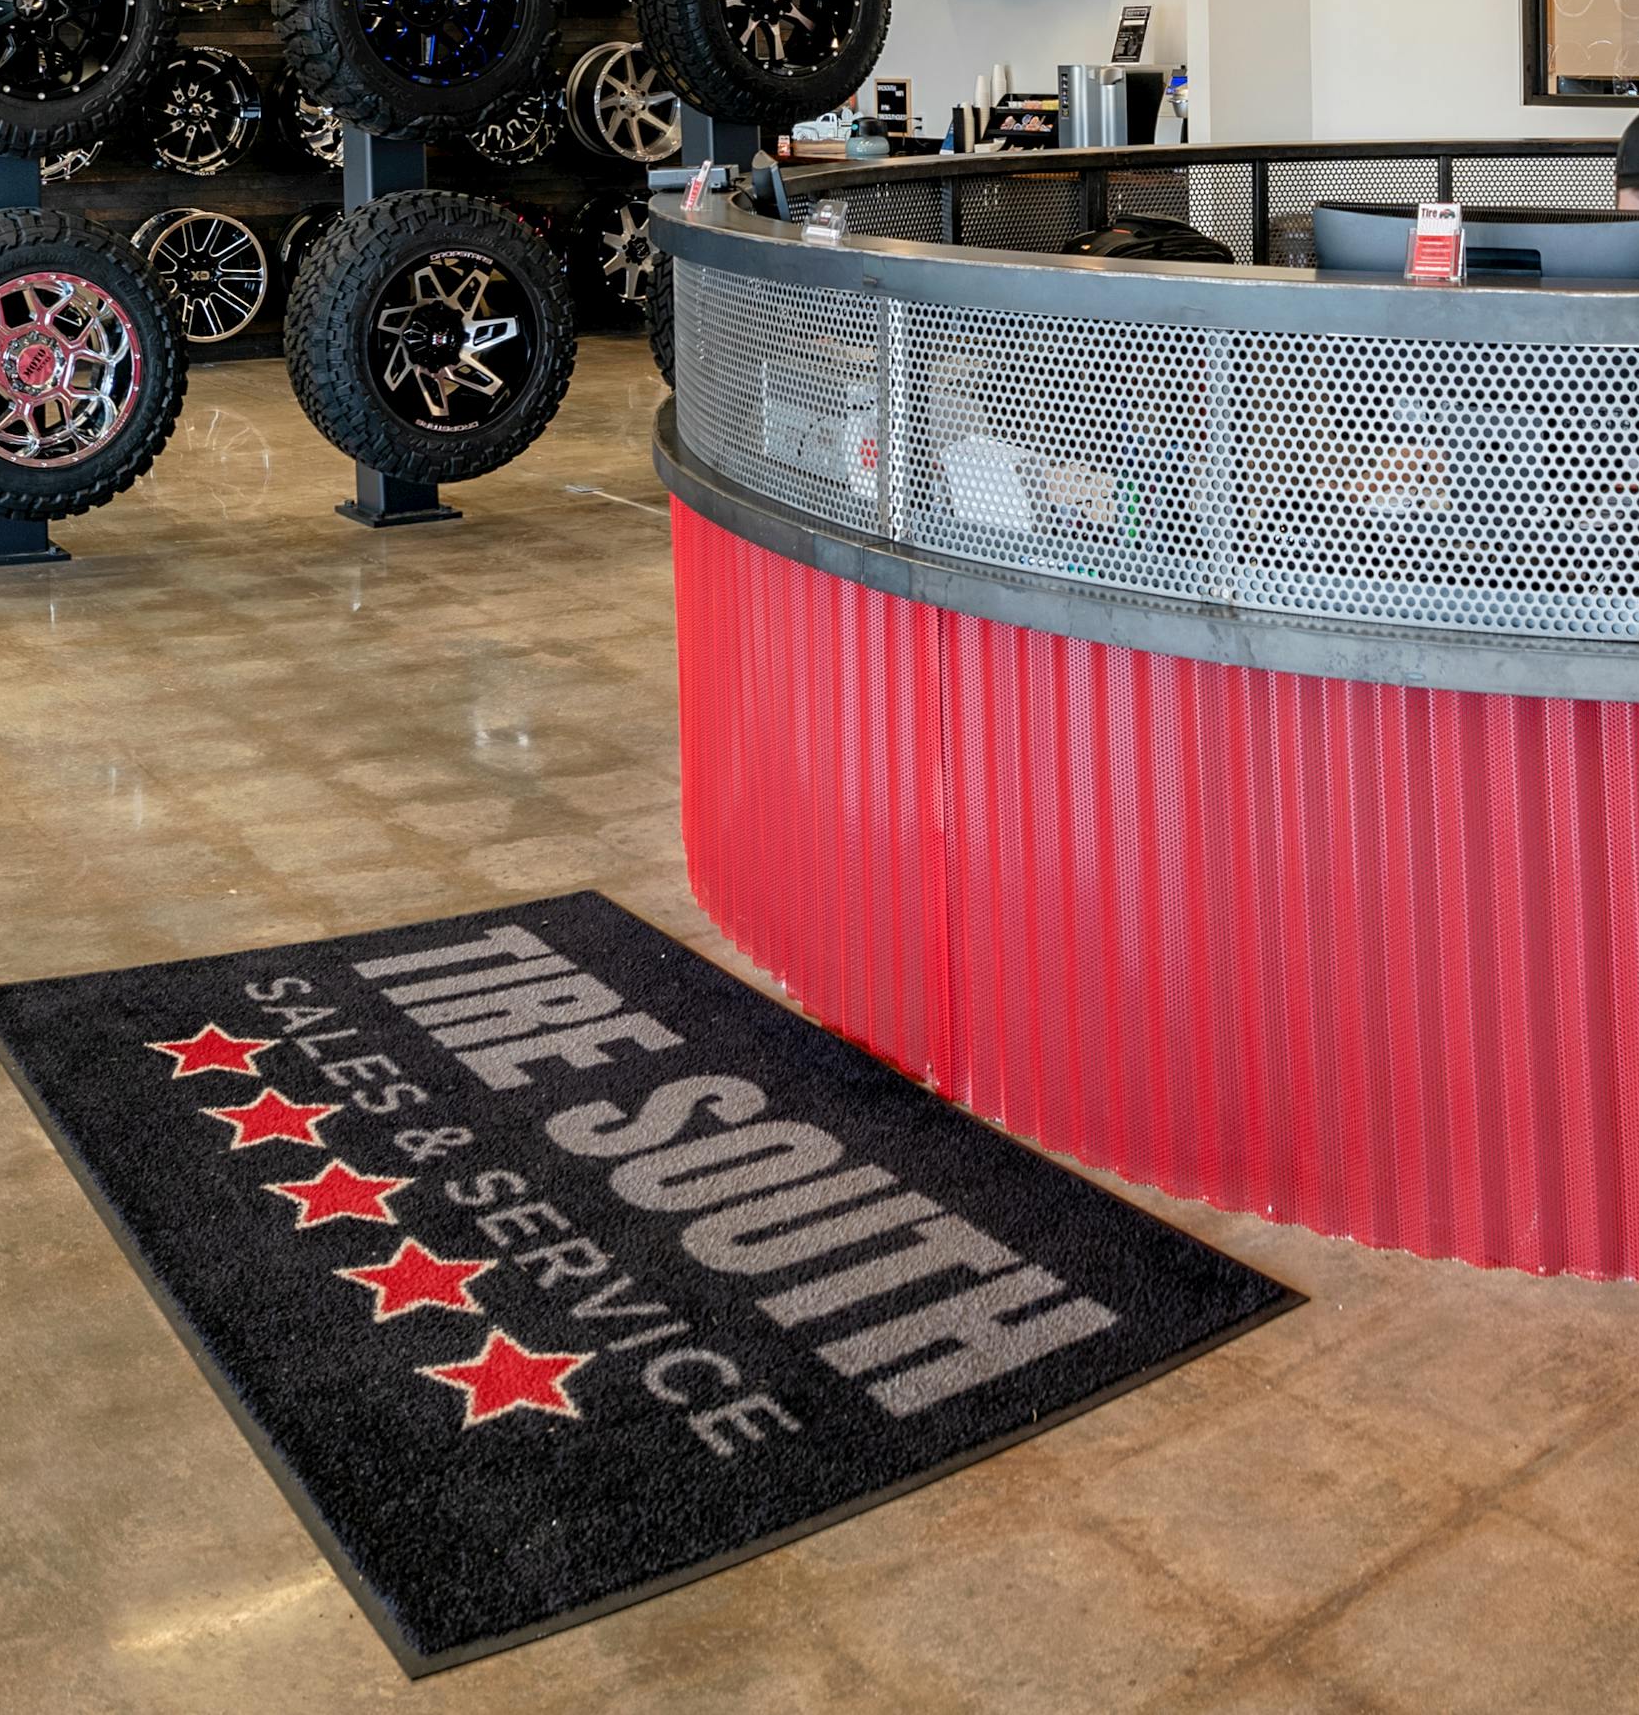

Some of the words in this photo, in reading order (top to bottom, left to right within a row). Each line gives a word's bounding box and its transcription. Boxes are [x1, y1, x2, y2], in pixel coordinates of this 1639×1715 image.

[1421, 208, 1438, 218] Tire
[24, 348, 46, 377] MOTO
[245, 974, 431, 1117] SALES
[393, 1125, 474, 1163] &
[445, 1167, 803, 1459] SERVICE
[352, 924, 685, 1090] TIRE
[545, 1073, 1119, 1419] SOUTH
